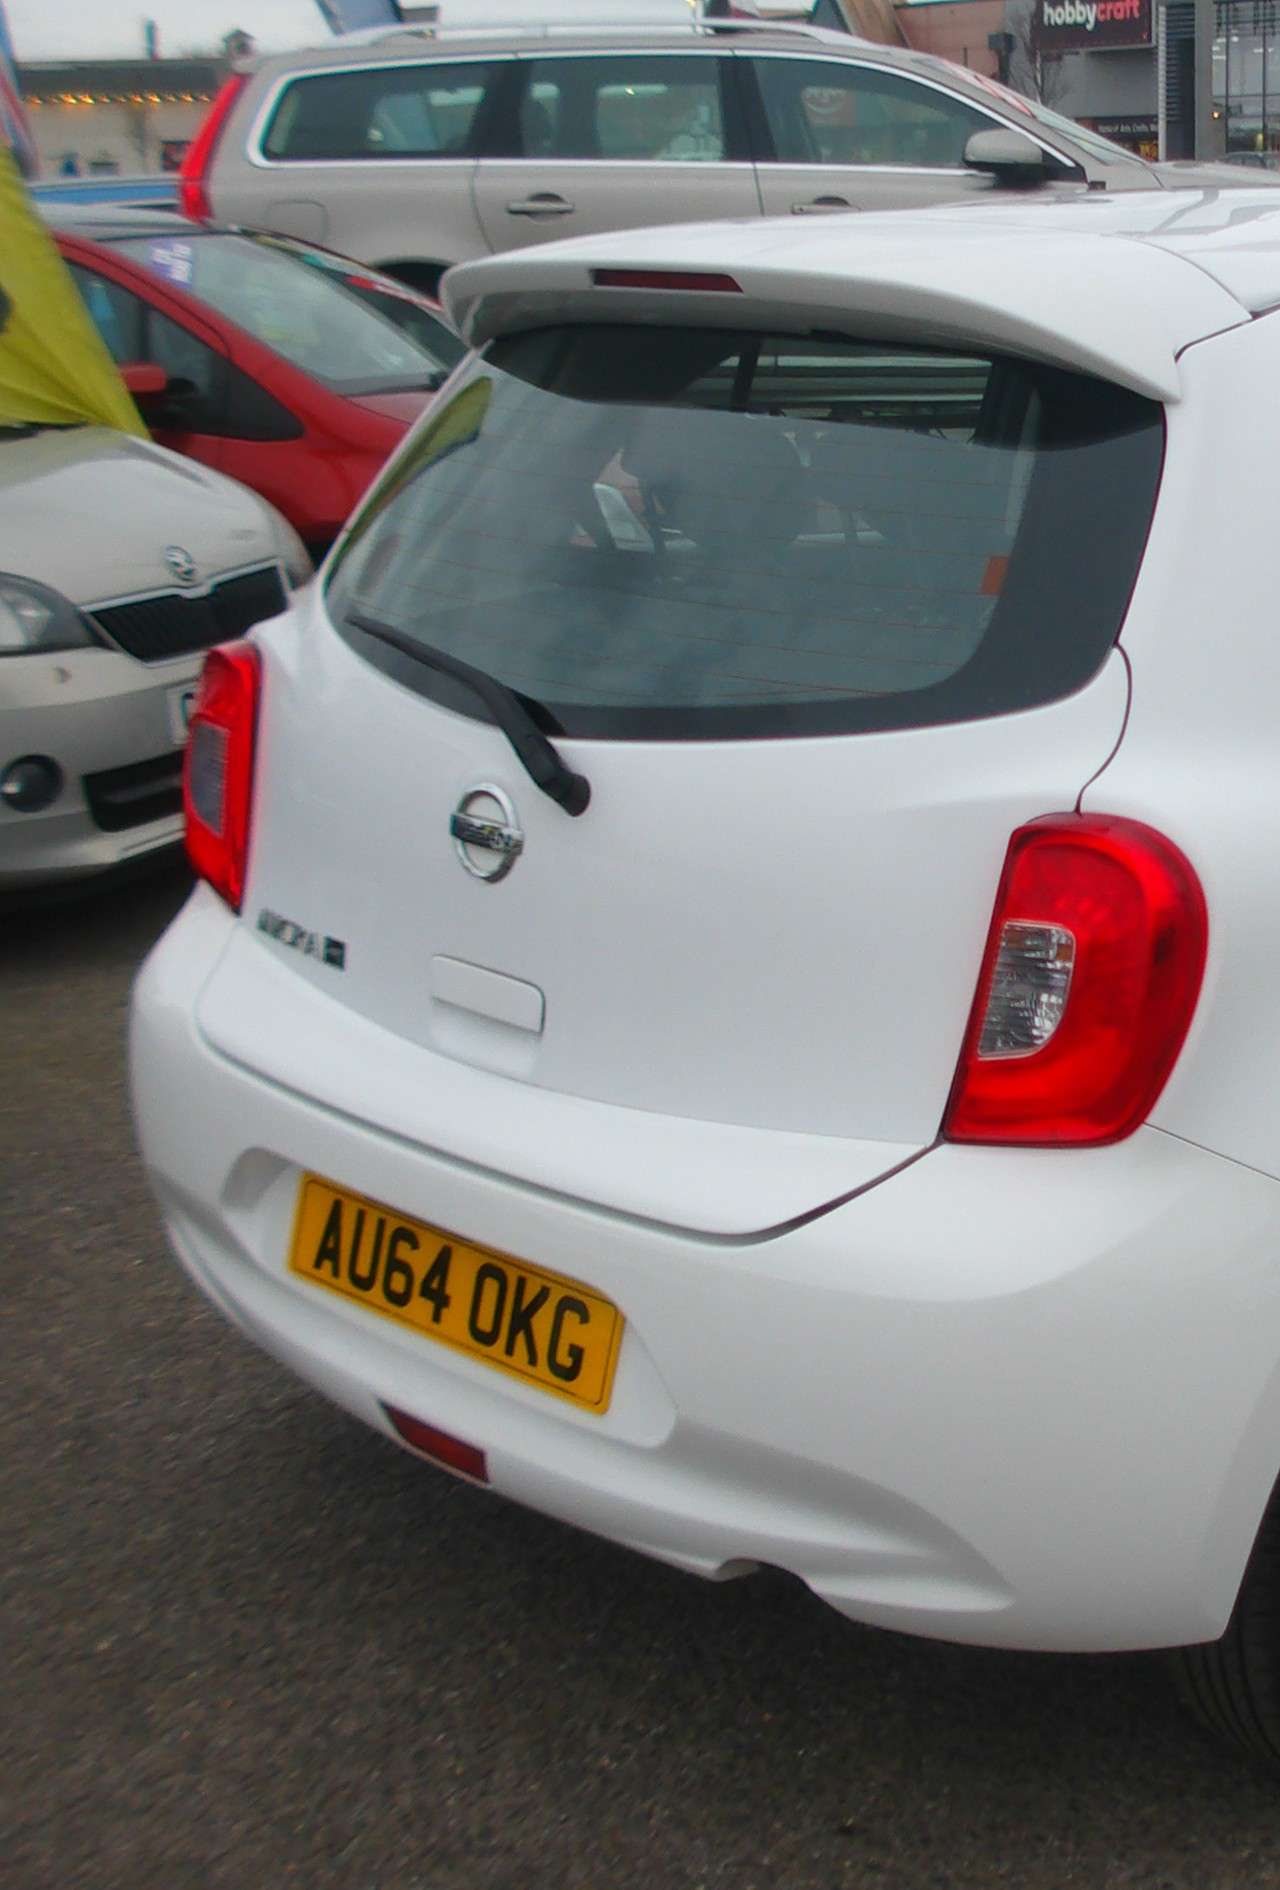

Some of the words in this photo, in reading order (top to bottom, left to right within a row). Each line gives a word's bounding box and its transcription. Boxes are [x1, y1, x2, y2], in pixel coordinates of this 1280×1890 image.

[1043, 0, 1140, 31] hobbycraft
[313, 1199, 452, 1325] AU64
[468, 1262, 590, 1382] OKG
